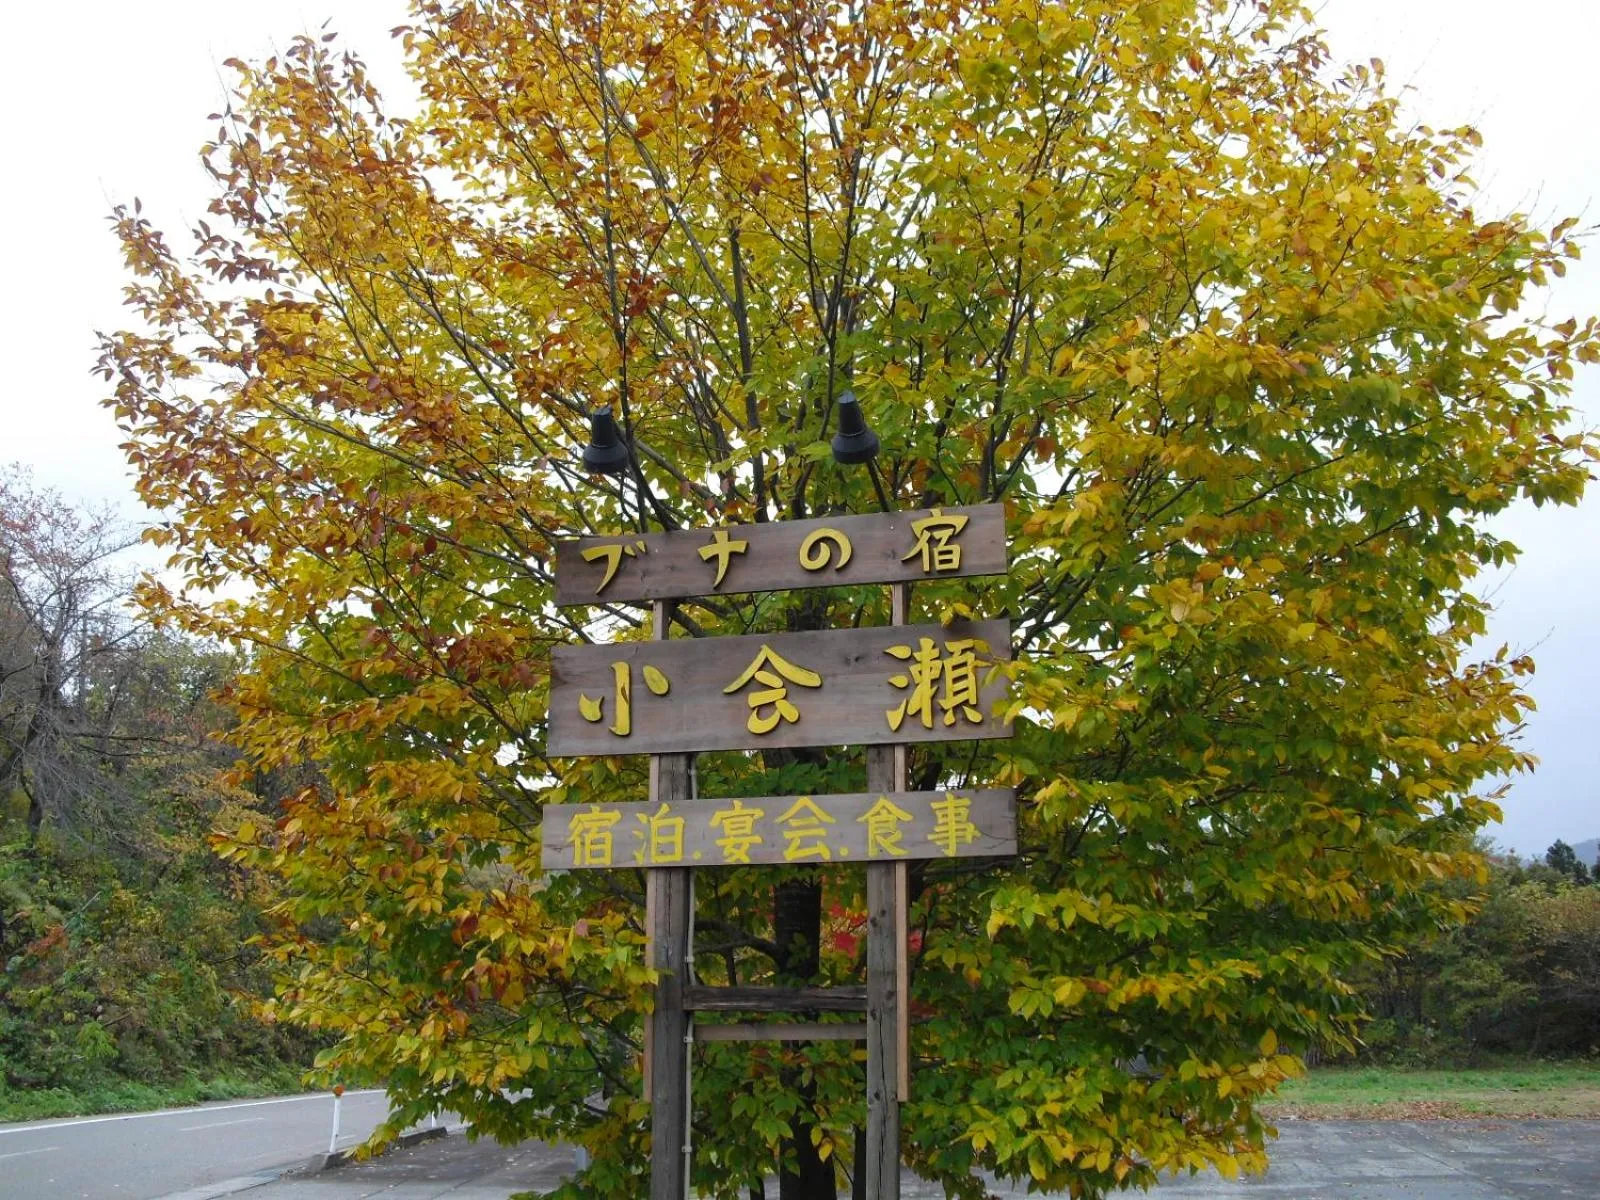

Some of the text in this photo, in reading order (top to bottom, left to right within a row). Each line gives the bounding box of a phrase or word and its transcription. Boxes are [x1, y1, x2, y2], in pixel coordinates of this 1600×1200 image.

[581, 509, 969, 594] ブナの宿
[579, 637, 984, 736] 小会瀬
